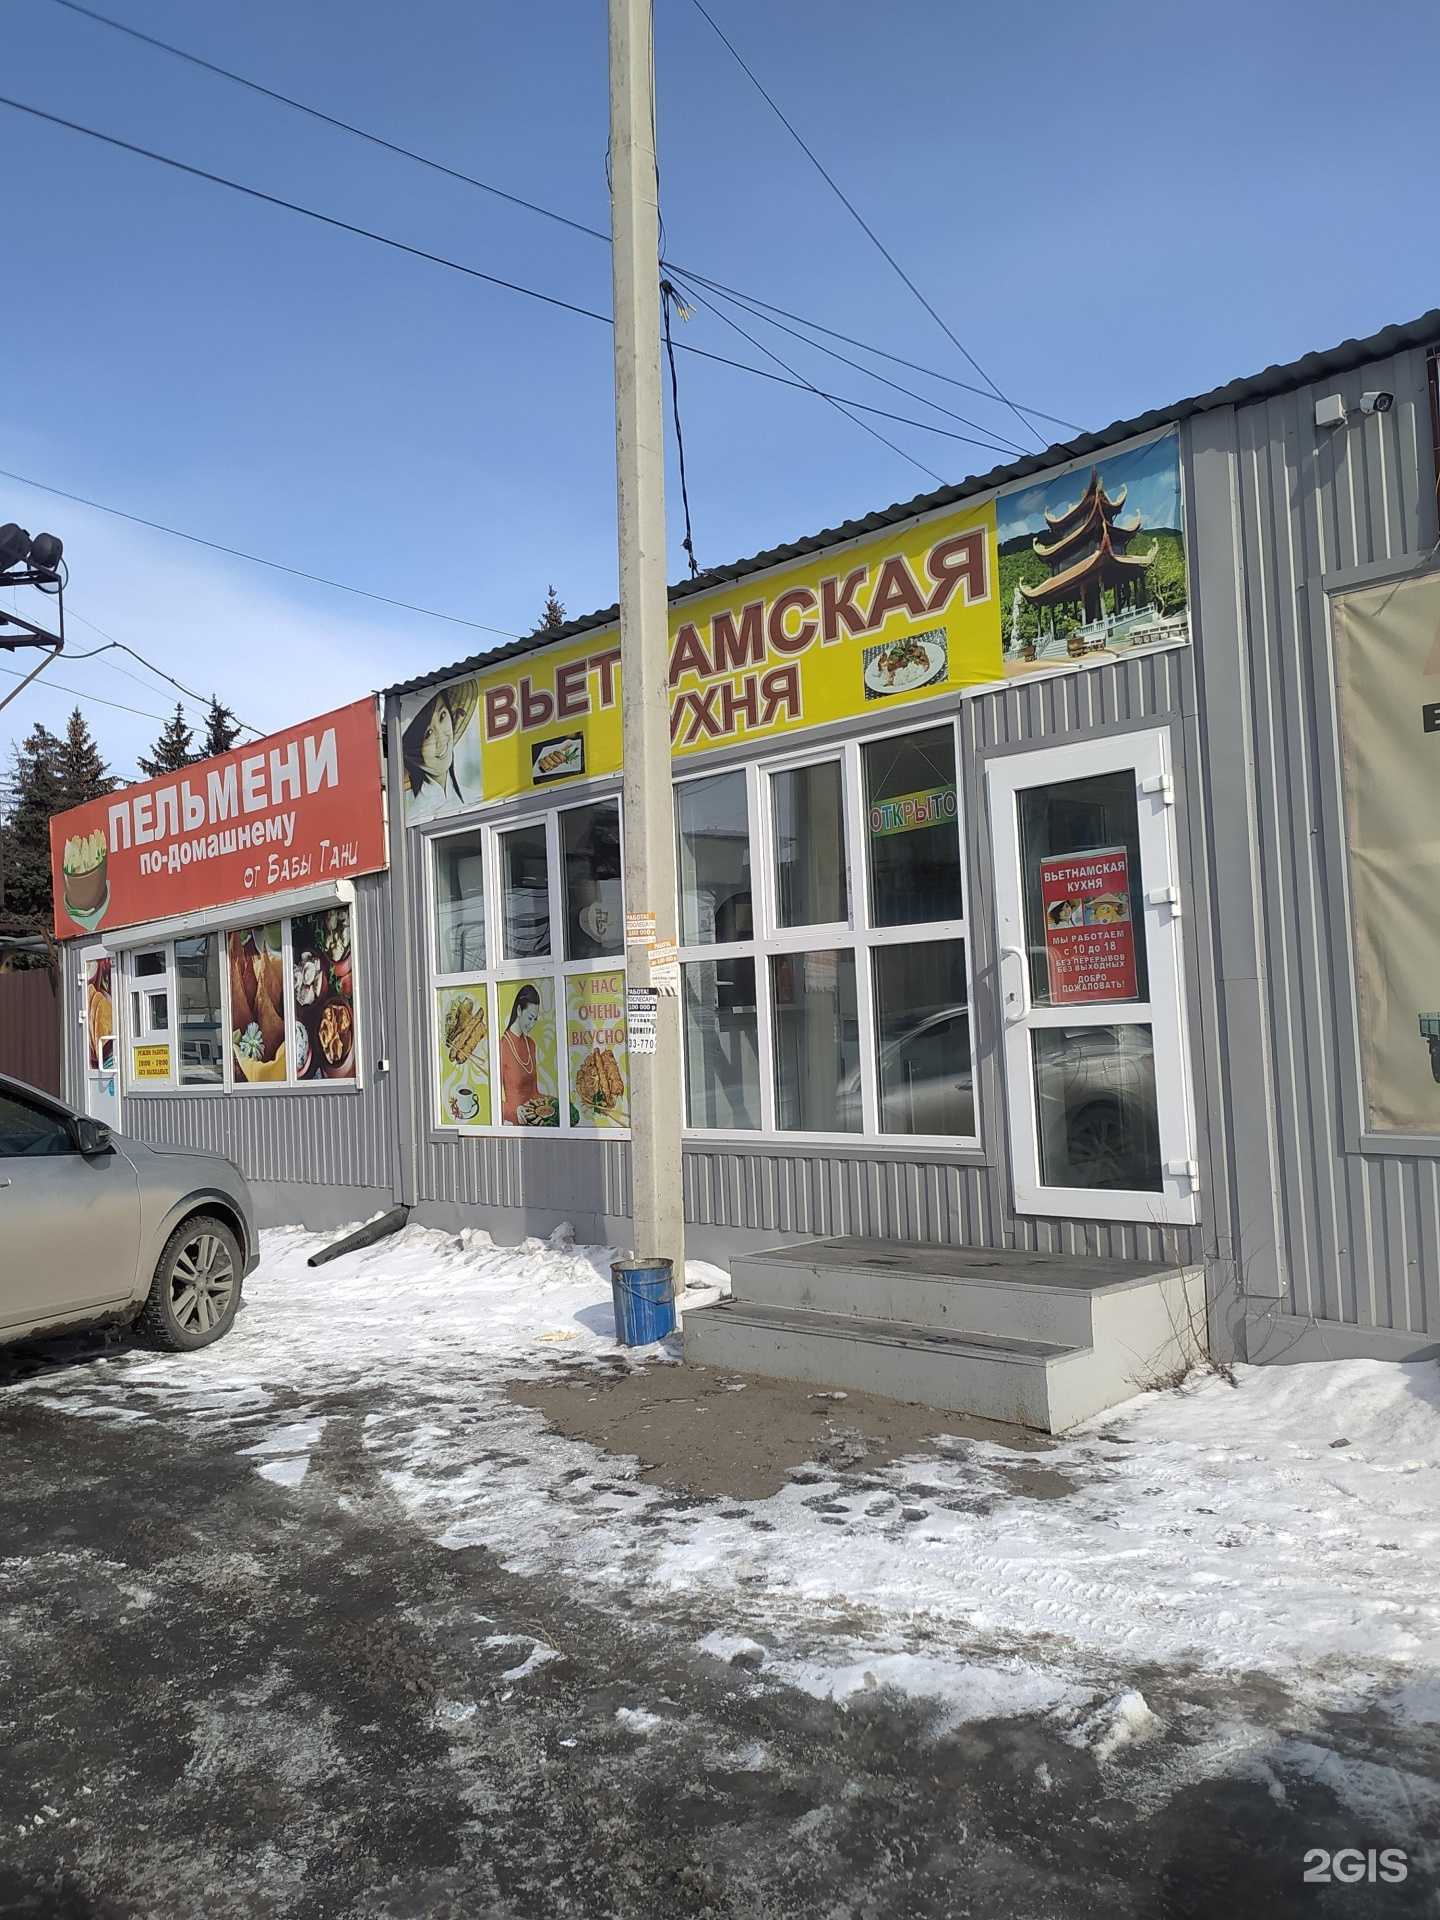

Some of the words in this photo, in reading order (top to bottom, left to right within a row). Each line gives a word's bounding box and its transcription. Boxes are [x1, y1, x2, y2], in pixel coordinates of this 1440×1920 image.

[484, 526, 988, 743] ВЬЕТАМСКАЯ
[108, 728, 338, 852] ПЕЛЬМЕНИ
[870, 790, 958, 833] ОТКРЫТО
[140, 811, 296, 875] по-домашнему
[243, 865, 261, 889] от
[1044, 861, 1125, 882] ВЬЕТНАМСКАЯ
[1066, 877, 1104, 893] КУХНЯ
[1052, 936, 1069, 945] МЫ
[1071, 930, 1125, 943] РАБОТАЕМ
[1073, 944, 1085, 954] 10
[1088, 945, 1101, 955] до
[1104, 941, 1117, 951] 18
[1056, 959, 1072, 968] БЕЗ
[1073, 953, 1126, 965] ПЕРЕРЫВОВ
[1057, 966, 1073, 974] БЕЗ
[1075, 960, 1126, 972] ВЫХОДНЫХ
[576, 979, 587, 994] У
[592, 977, 618, 994] НАС
[1062, 980, 1126, 993] ПОЖАЛОВАТЬ!
[1077, 973, 1107, 984] ДОБРО
[578, 1003, 621, 1021] ОЧЕНЬ
[571, 1028, 625, 1046] ВКУСНО
